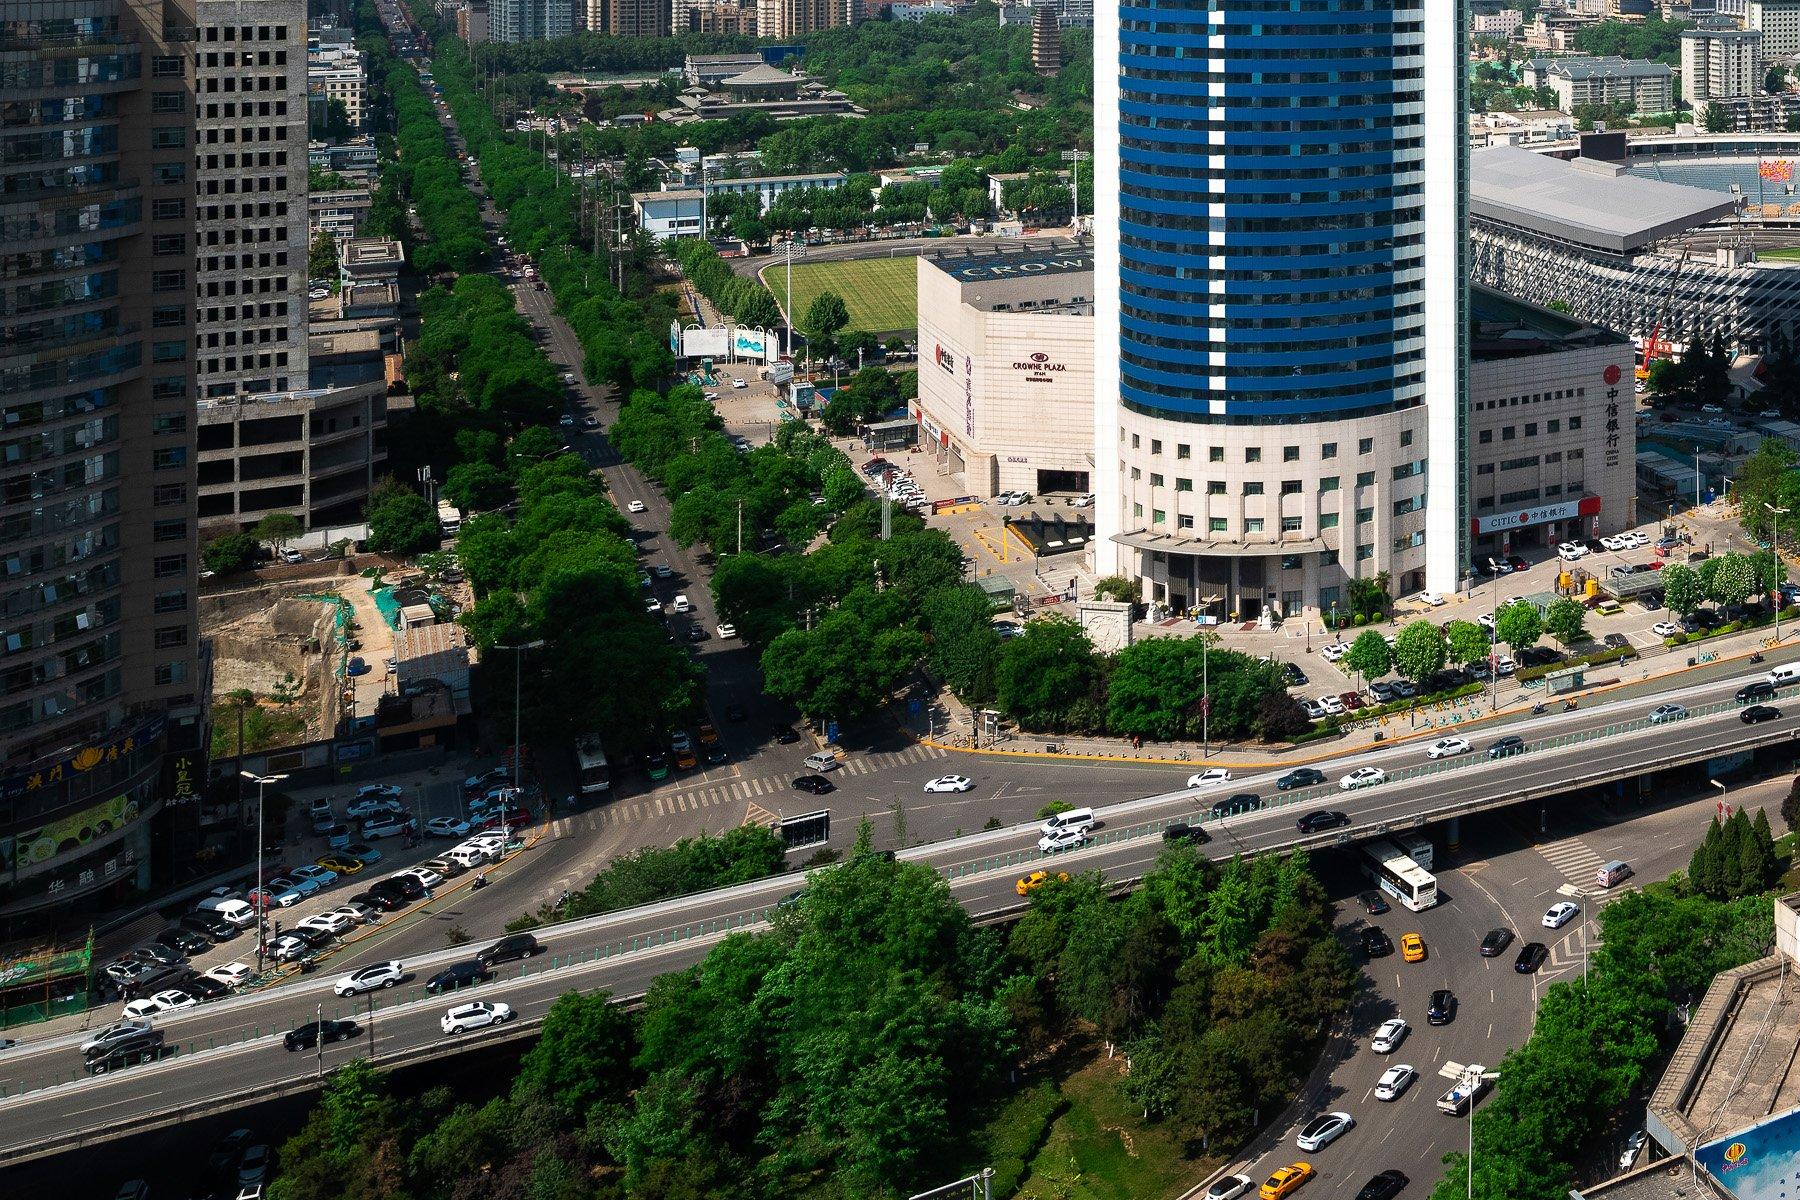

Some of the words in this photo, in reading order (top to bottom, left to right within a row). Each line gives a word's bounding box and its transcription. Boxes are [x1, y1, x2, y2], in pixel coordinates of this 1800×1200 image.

[1013, 362, 1042, 371] CROWNE
[1044, 363, 1067, 372] PLAZA
[1490, 516, 1517, 528] CITIC
[48, 849, 135, 894] 华融国际
